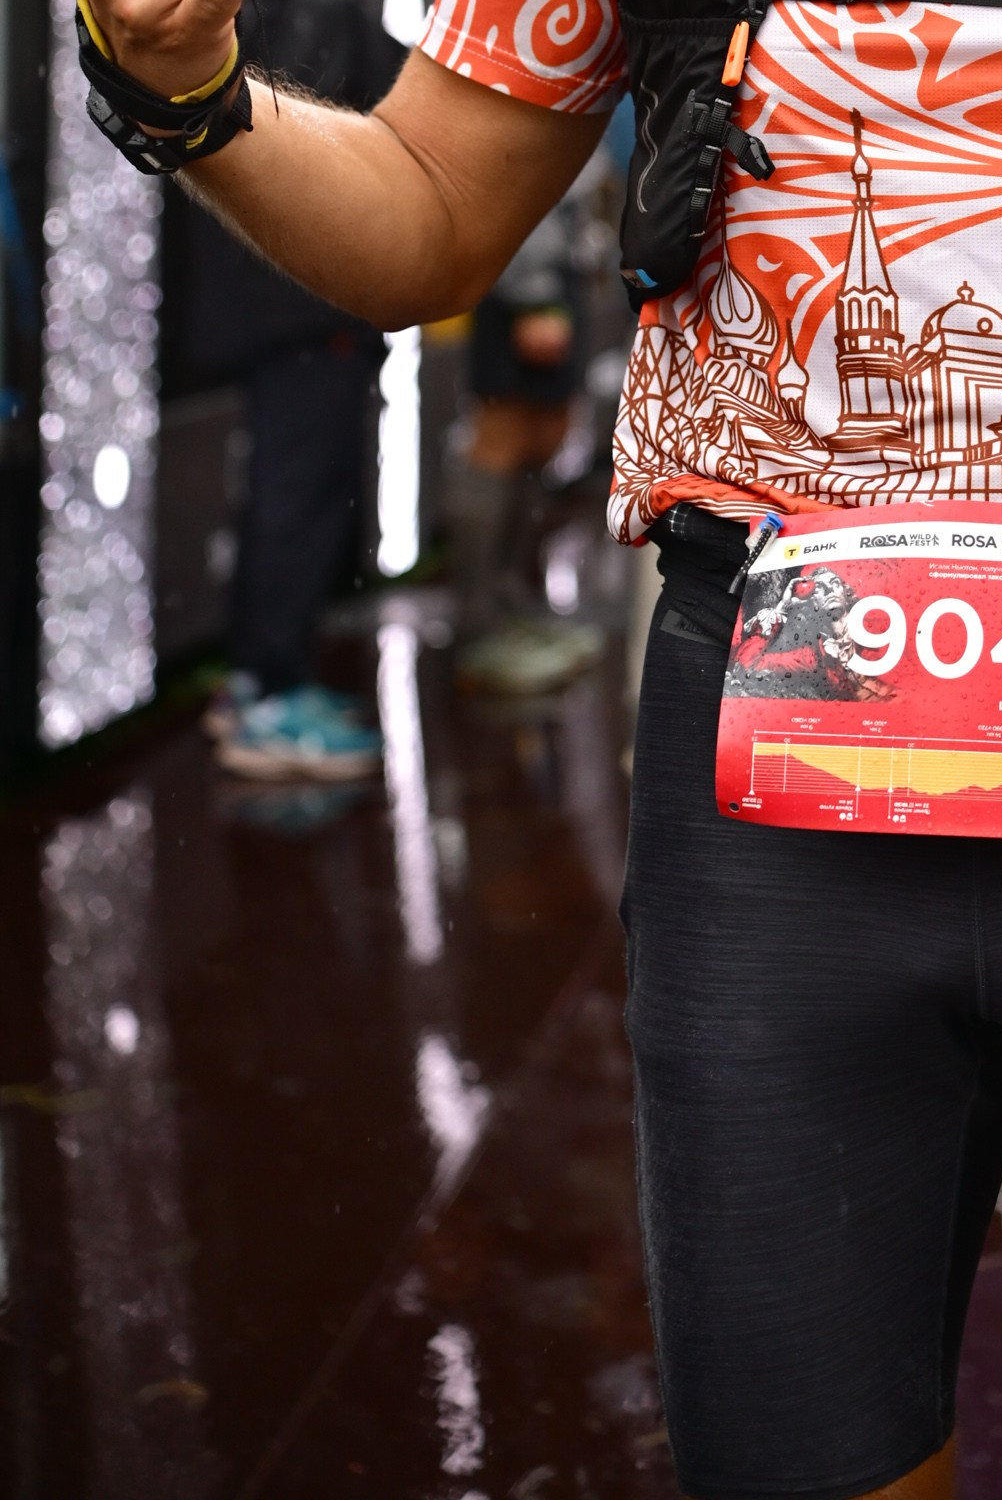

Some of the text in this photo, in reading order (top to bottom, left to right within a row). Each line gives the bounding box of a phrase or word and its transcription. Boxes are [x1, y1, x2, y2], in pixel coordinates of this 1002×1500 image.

[860, 534, 908, 549] ROSA
[909, 533, 932, 541] WILD
[951, 534, 997, 549] ROSA
[803, 541, 838, 555] БАНК
[928, 571, 986, 580] сформулировал
